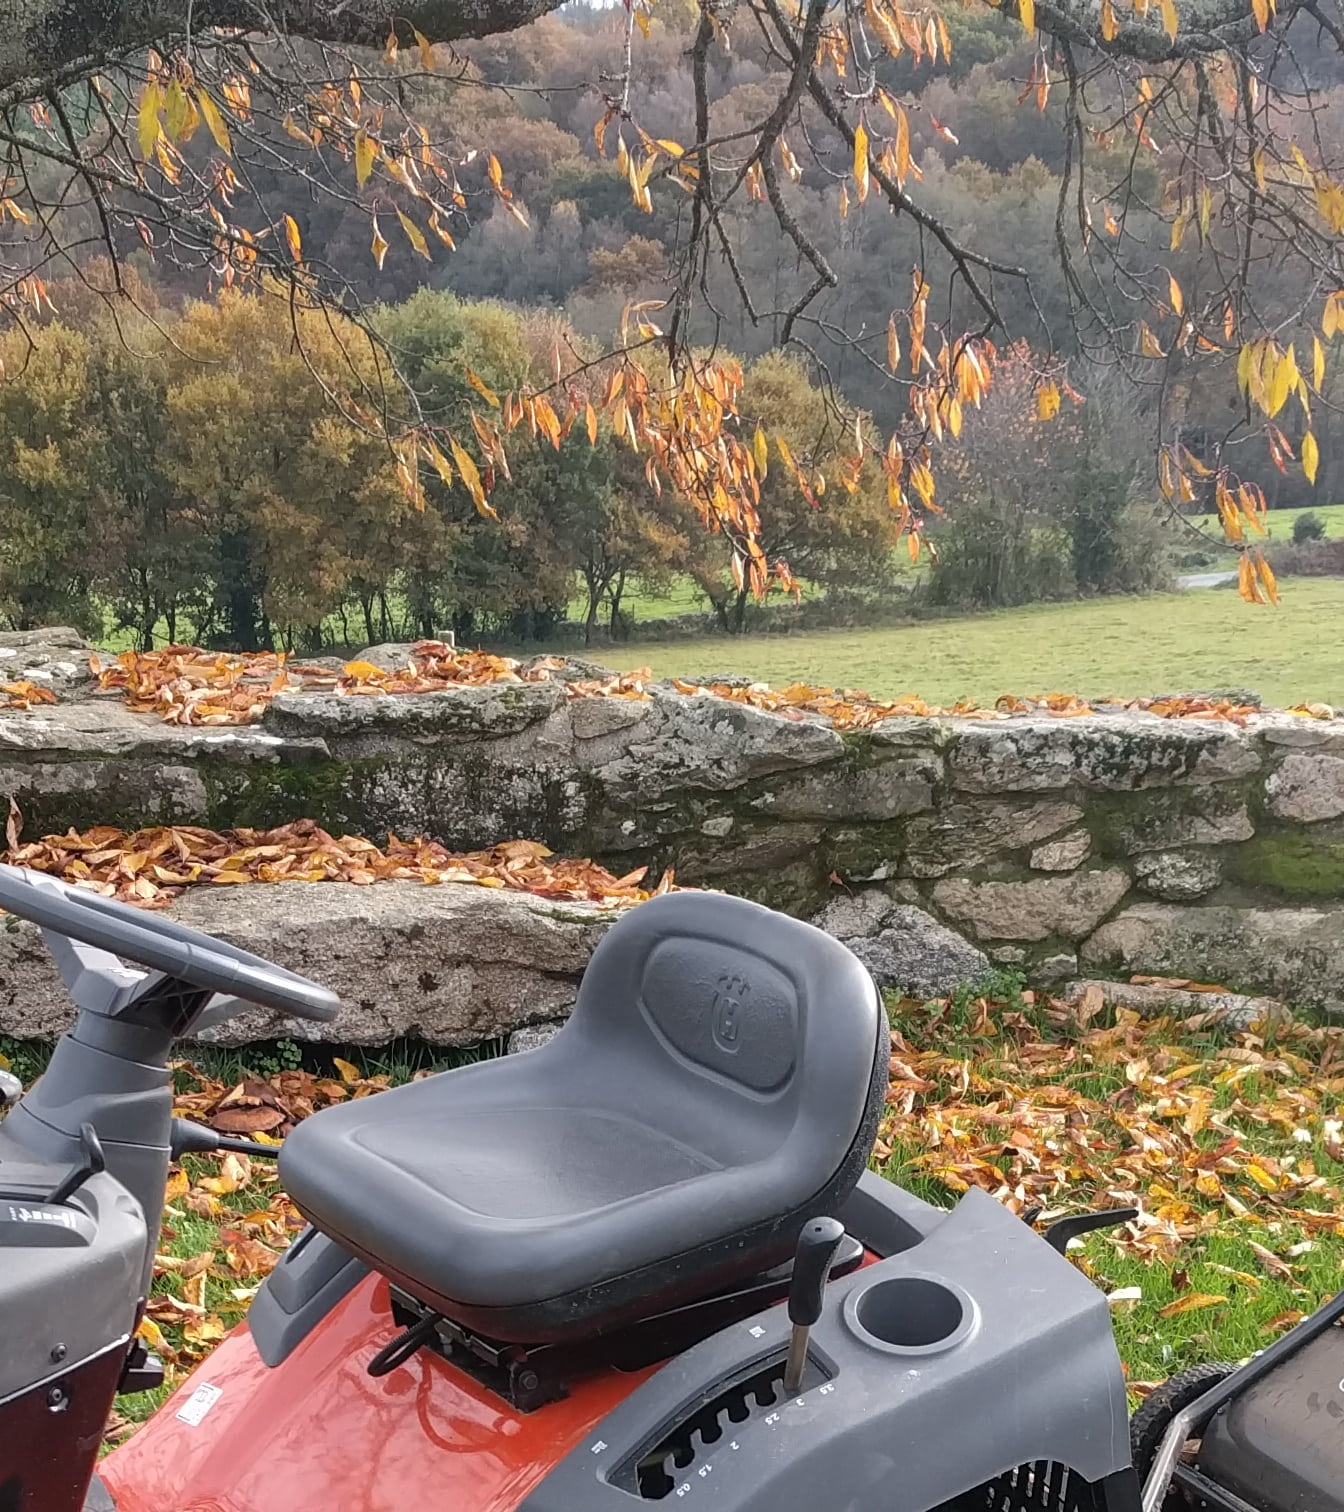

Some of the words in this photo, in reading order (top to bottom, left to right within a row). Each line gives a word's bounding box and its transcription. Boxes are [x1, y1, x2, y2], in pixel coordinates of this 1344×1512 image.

[819, 1383, 835, 1396] 3.5
[764, 1412, 780, 1425] 2.5
[698, 1463, 713, 1478] 1.5
